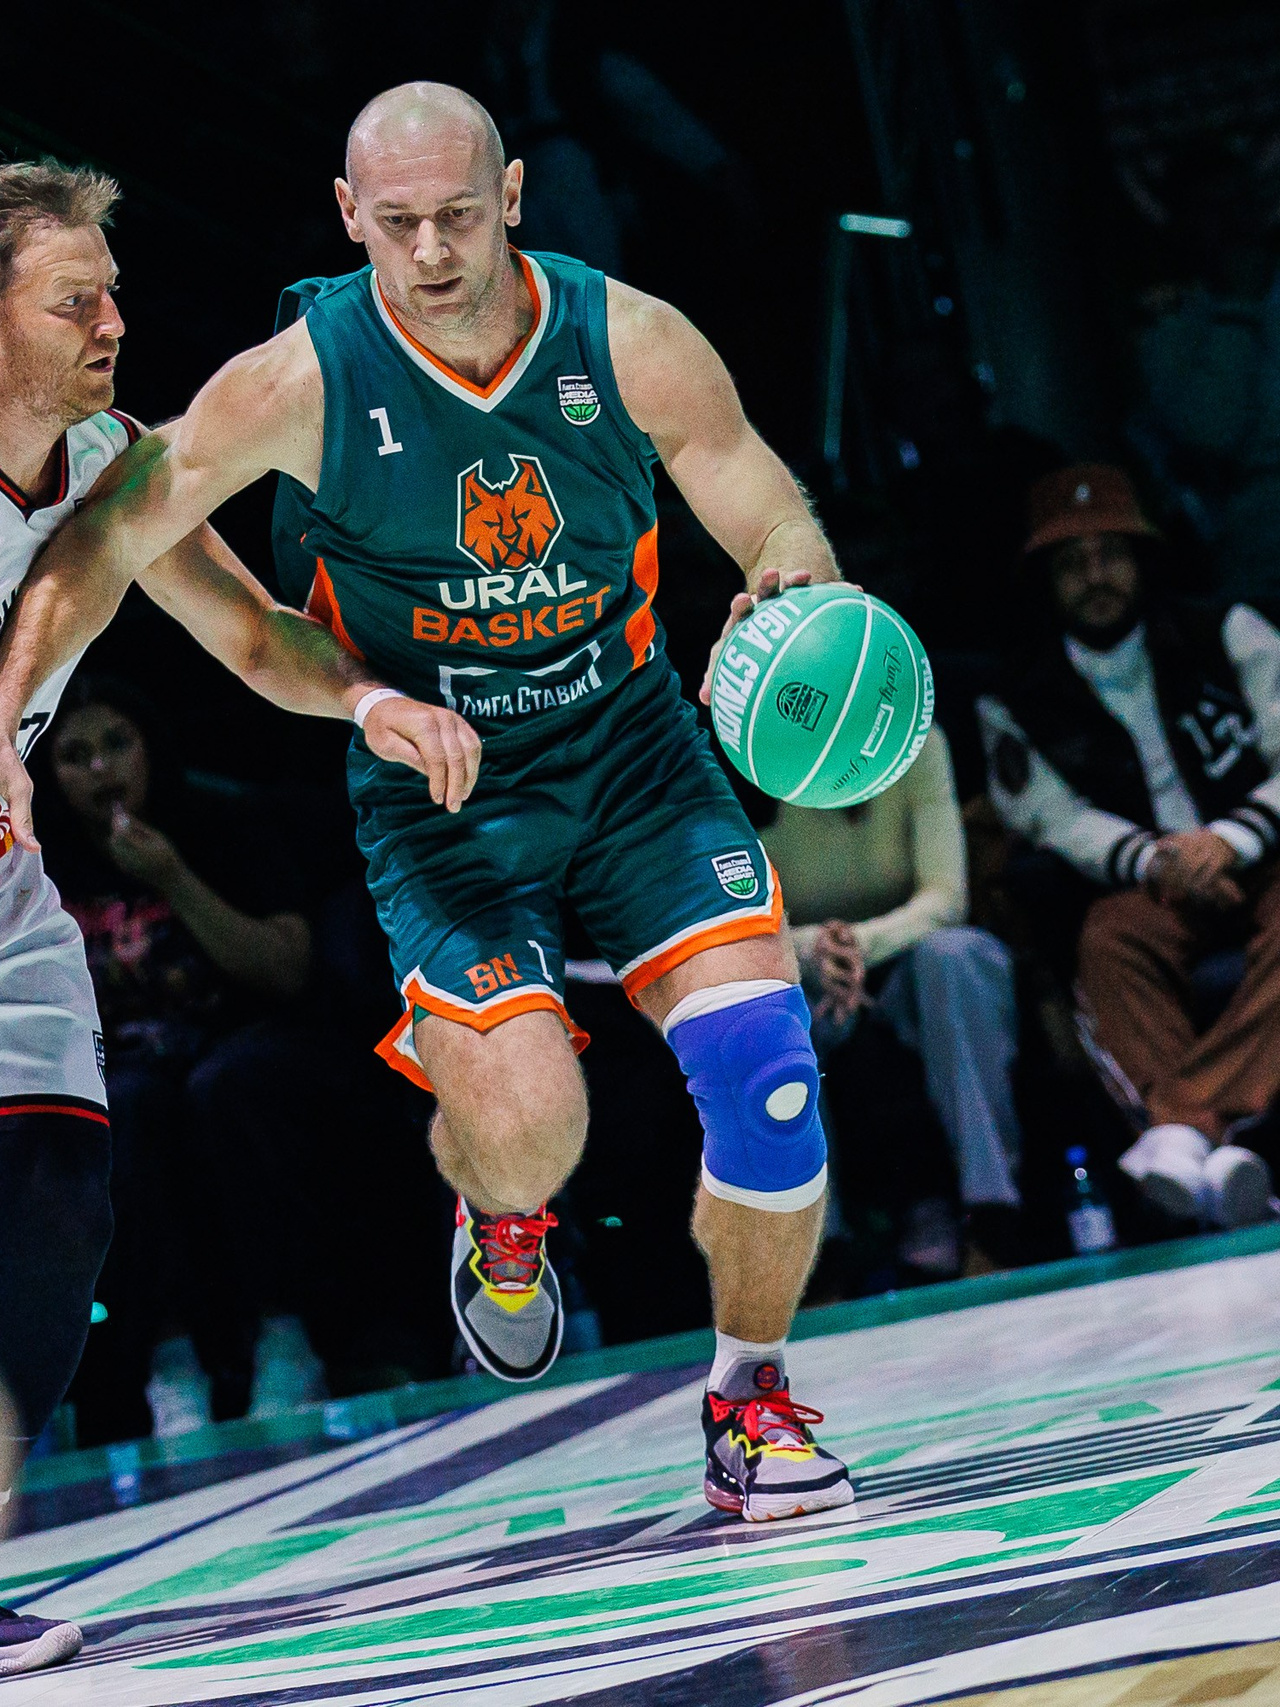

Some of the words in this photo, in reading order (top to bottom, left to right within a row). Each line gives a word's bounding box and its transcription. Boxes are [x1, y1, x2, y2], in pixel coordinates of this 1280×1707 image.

[559, 390, 597, 399] MEDIA
[369, 407, 403, 456] 1
[438, 563, 587, 610] URAL
[413, 585, 611, 647] BASKET
[738, 598, 802, 655] LIGA
[714, 645, 760, 754] STAVOK
[527, 940, 554, 984] 1
